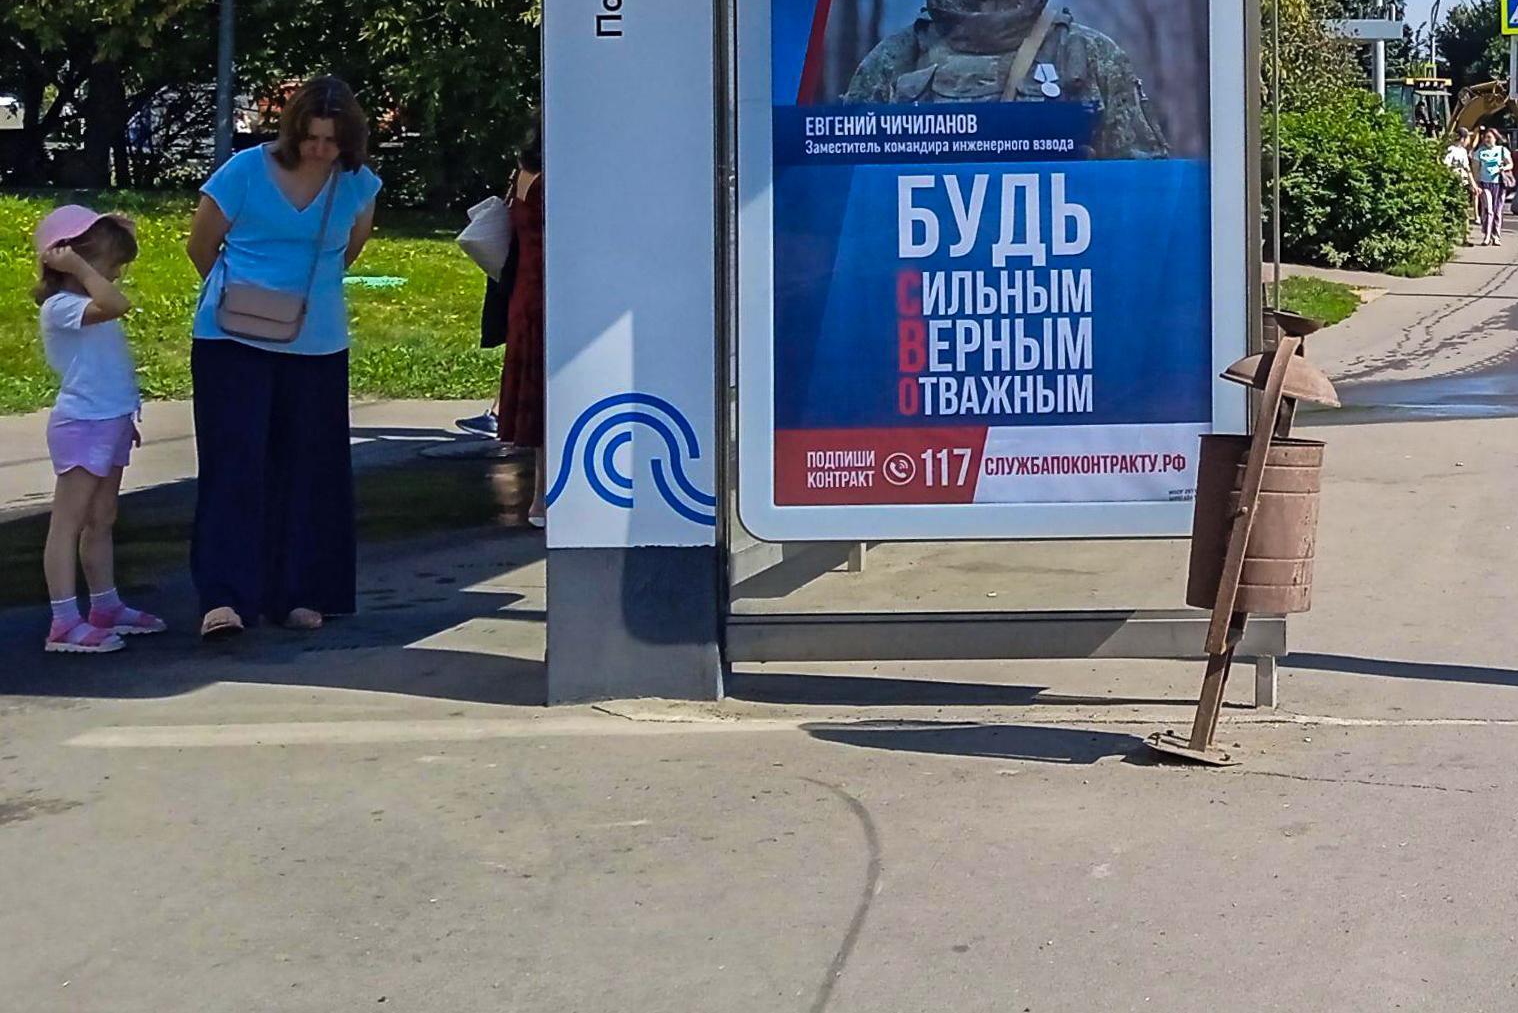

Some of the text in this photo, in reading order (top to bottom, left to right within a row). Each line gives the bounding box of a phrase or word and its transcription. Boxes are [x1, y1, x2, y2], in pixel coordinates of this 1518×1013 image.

[805, 111, 978, 136] ЕВГЕНИЙ ЧИЧИЛАНОВ
[805, 138, 1074, 155] Заместитель командира инженерного взвода
[898, 173, 1092, 268] БУДЬ
[896, 269, 1093, 316] СИЛЬНЫМ
[899, 317, 1093, 373] ВЕРНЫМ
[898, 374, 1093, 417] ОТВАЖНЫМ
[807, 450, 876, 469] ПОДПИШИ
[921, 448, 972, 487] 117
[984, 453, 1187, 477] СЛУЖБАПОКОНТРАКТУ.РФ
[807, 470, 875, 488] КОНТРАКТ
